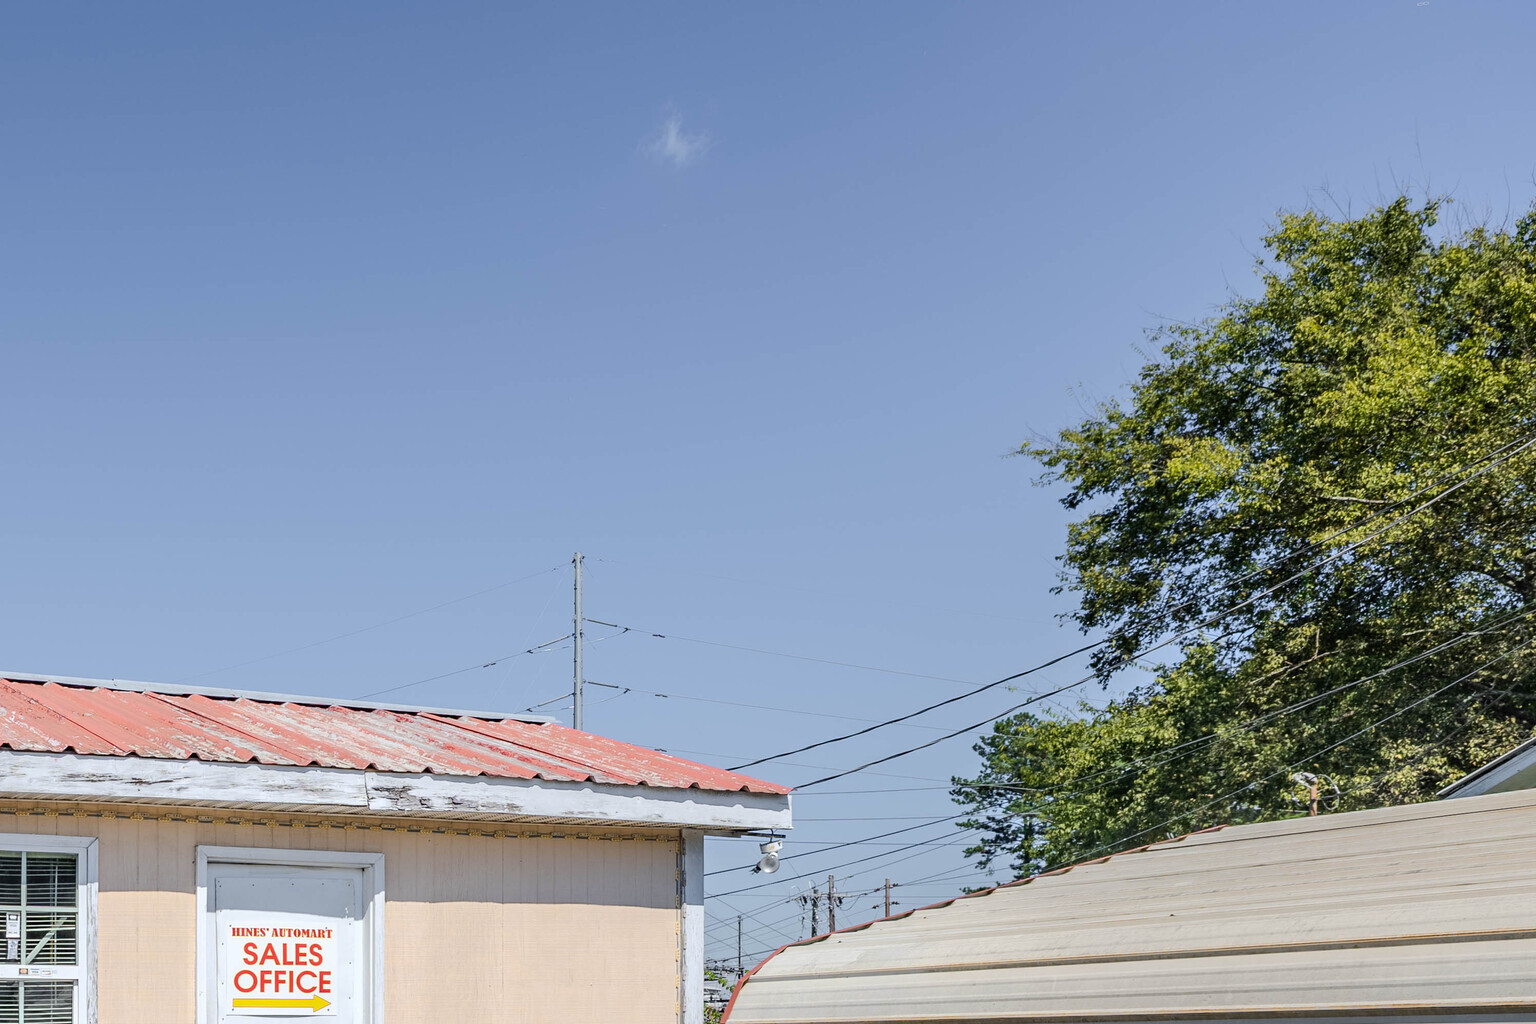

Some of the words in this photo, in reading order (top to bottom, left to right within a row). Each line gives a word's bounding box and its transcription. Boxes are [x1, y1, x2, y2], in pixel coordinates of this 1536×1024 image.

[232, 927, 270, 937] HINES'
[272, 928, 333, 939] AUTOMART
[243, 942, 323, 966] SALES
[233, 969, 332, 993] OFFICE
